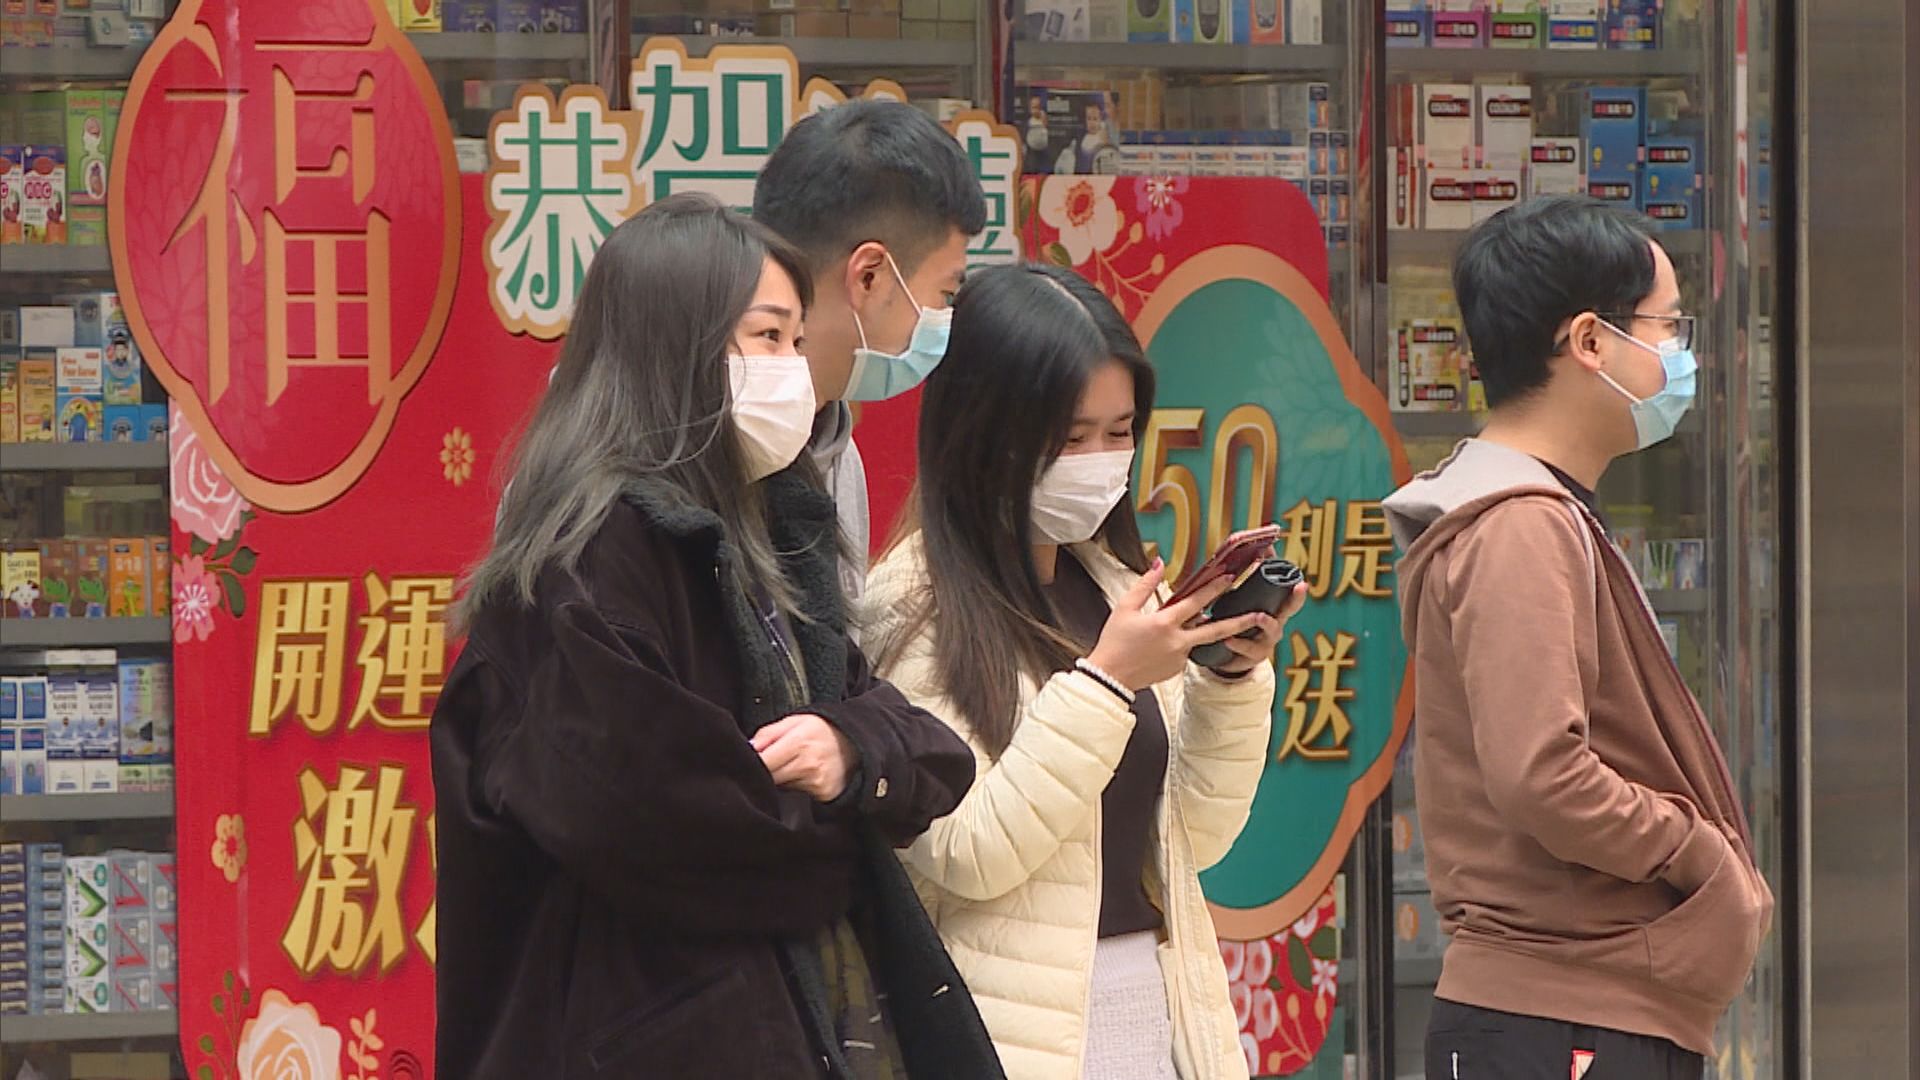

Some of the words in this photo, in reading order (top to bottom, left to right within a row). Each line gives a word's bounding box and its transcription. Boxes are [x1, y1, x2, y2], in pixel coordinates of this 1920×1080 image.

[159, 19, 393, 406] 福
[1279, 497, 1393, 599] 利是
[248, 570, 455, 738] 開運
[1277, 630, 1358, 763] 送
[281, 762, 436, 977] 激
